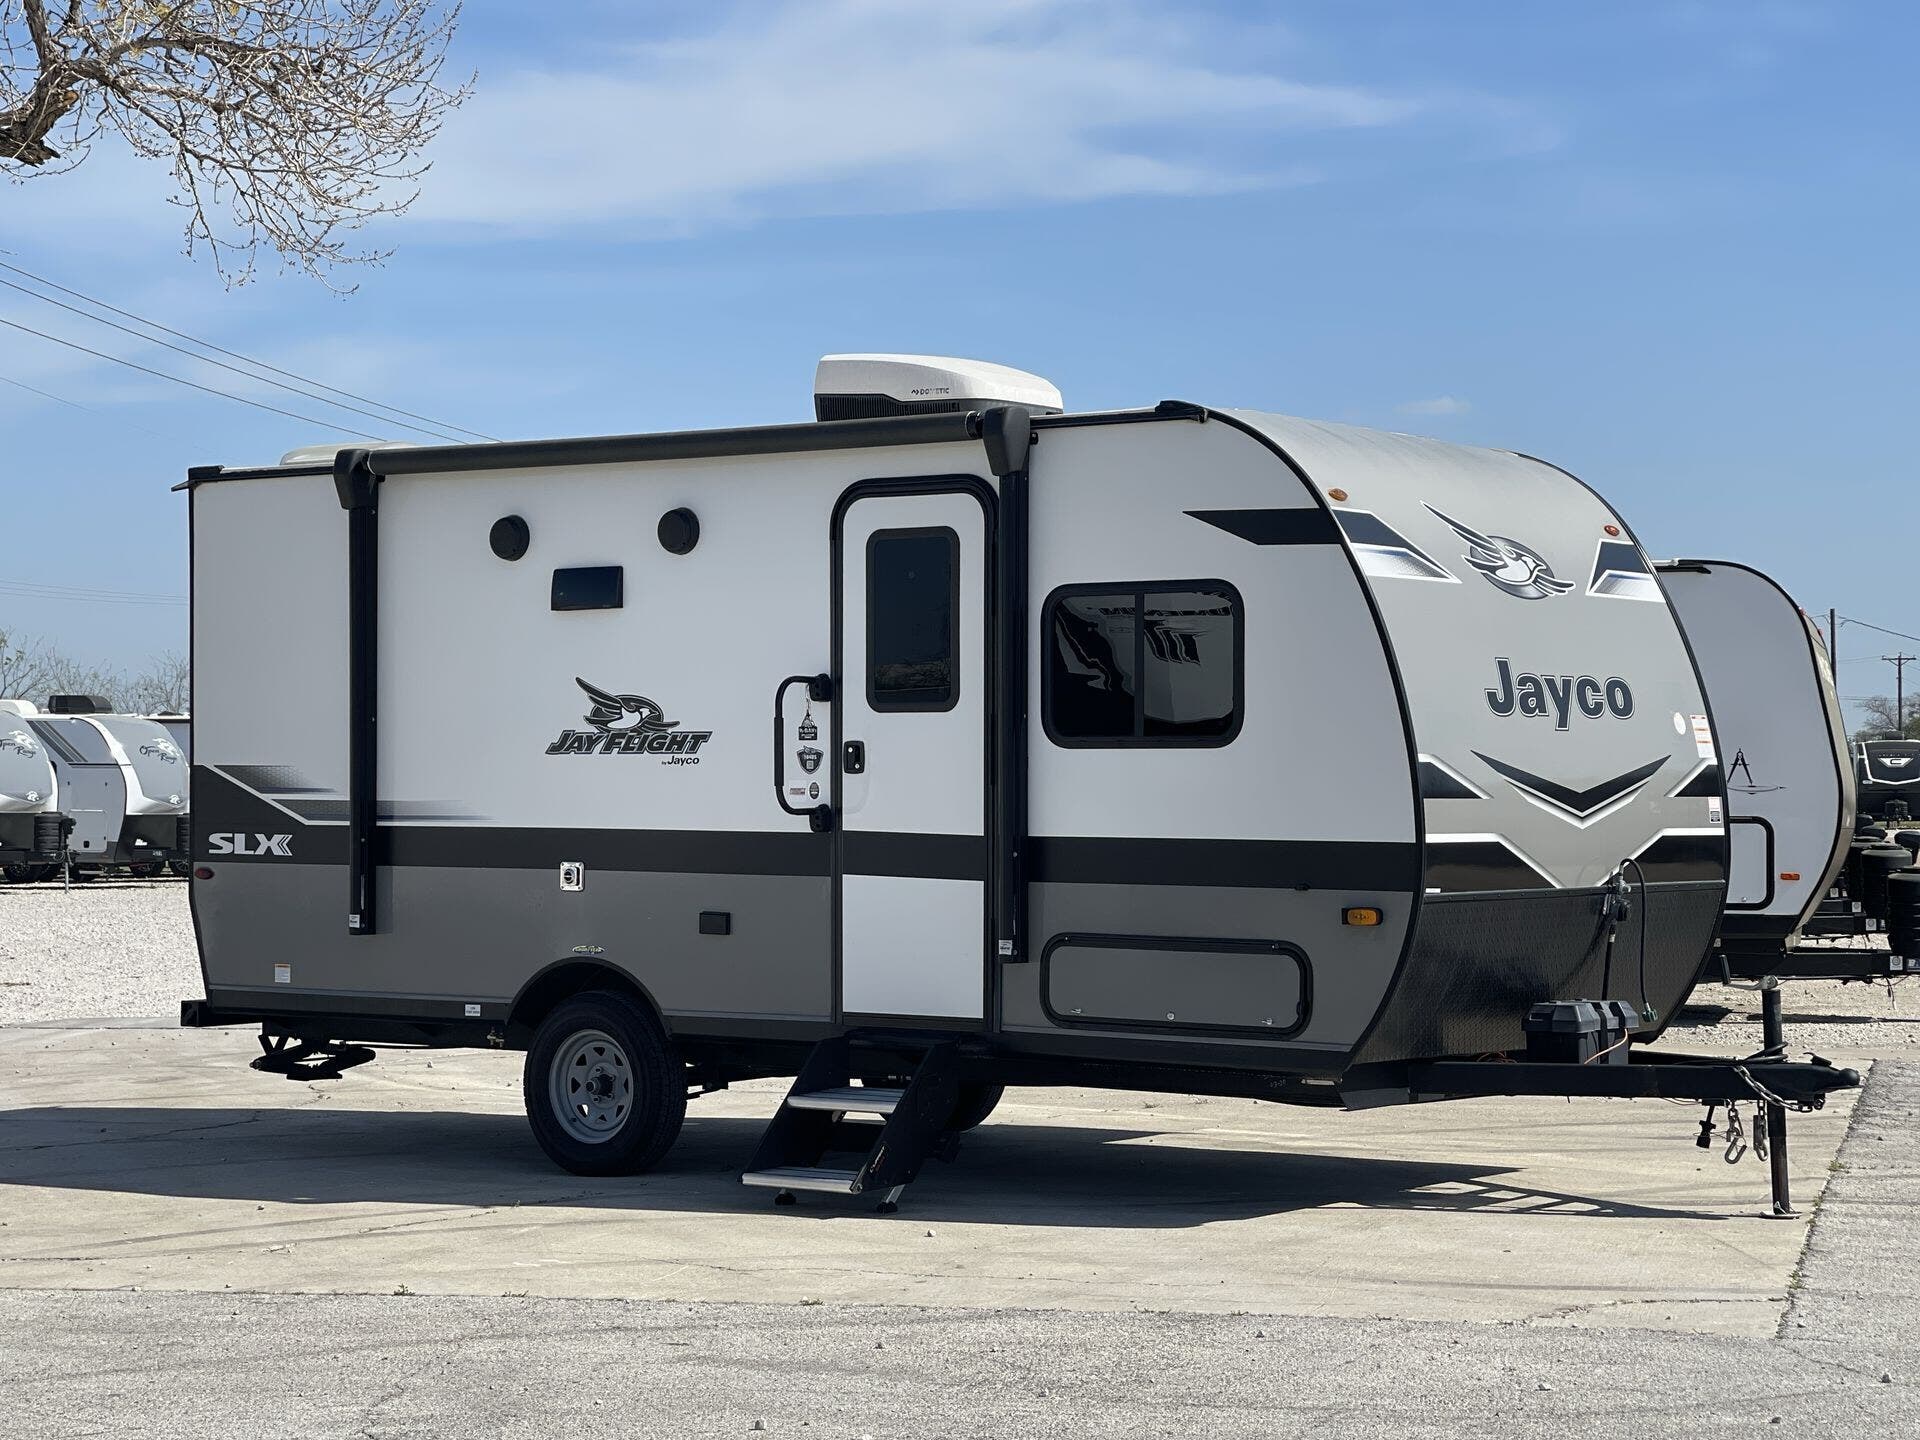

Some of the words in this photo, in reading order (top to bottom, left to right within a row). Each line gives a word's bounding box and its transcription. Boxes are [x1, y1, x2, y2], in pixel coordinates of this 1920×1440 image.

[1484, 656, 1635, 731] Jayco
[0, 738, 16, 750] pen
[545, 730, 606, 755] JAY
[599, 731, 713, 755] FLIGHT
[667, 755, 700, 767] Jayco
[208, 832, 293, 856] SLX
